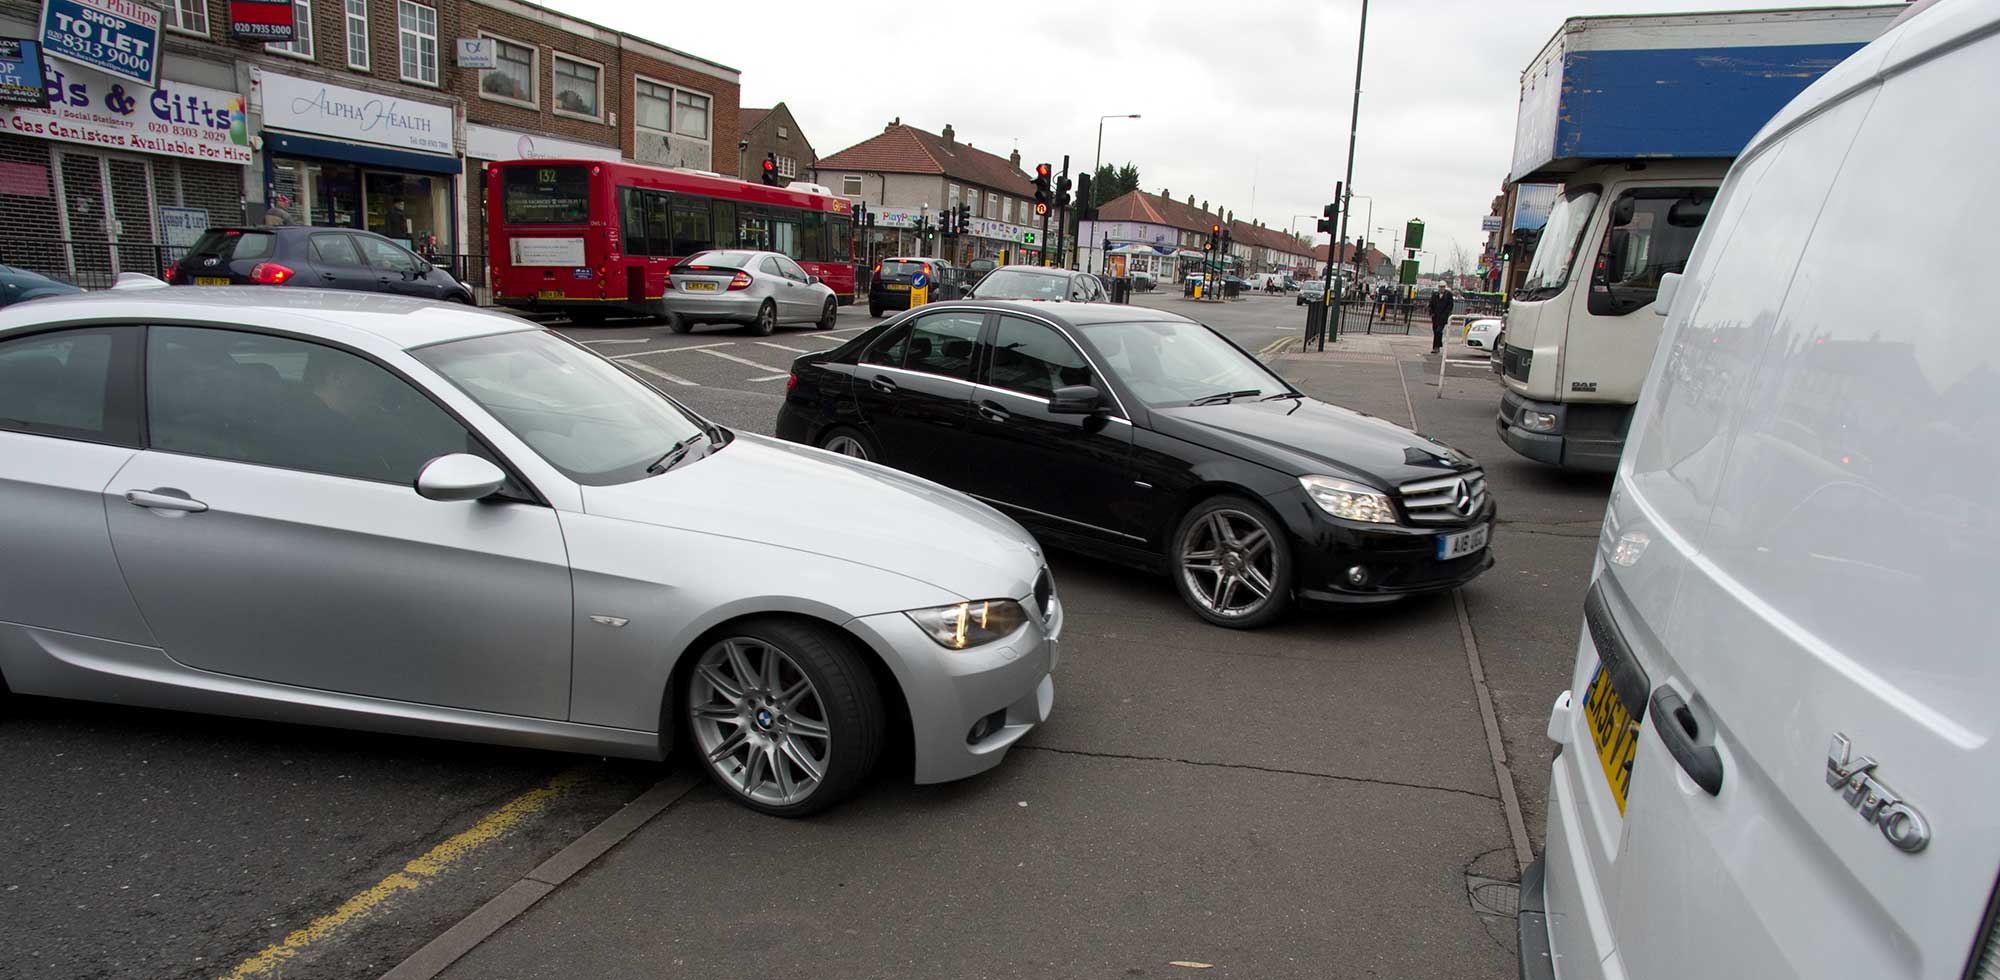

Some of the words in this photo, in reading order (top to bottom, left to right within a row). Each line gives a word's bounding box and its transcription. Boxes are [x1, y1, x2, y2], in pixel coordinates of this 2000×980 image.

[81, 8, 127, 30] SHOP
[107, 0, 157, 25] Philips
[56, 12, 92, 38] TO
[100, 28, 149, 57] LET
[235, 22, 250, 32] 020
[251, 23, 270, 33] 7935
[271, 25, 292, 35] 5000
[62, 33, 103, 58] 8313
[107, 48, 150, 72] 9000
[0, 62, 15, 74] OP
[46, 70, 89, 107] ds
[105, 84, 135, 116] &
[150, 89, 231, 131] Gifts
[64, 109, 90, 121] Social
[12, 116, 44, 134] Gas
[48, 121, 126, 146] Canisters
[130, 134, 195, 155] Available
[198, 144, 220, 158] For
[223, 146, 251, 162] Hire
[148, 122, 169, 133] 020
[172, 126, 198, 138] 8303
[202, 130, 226, 142] 2029
[538, 169, 557, 182] 132
